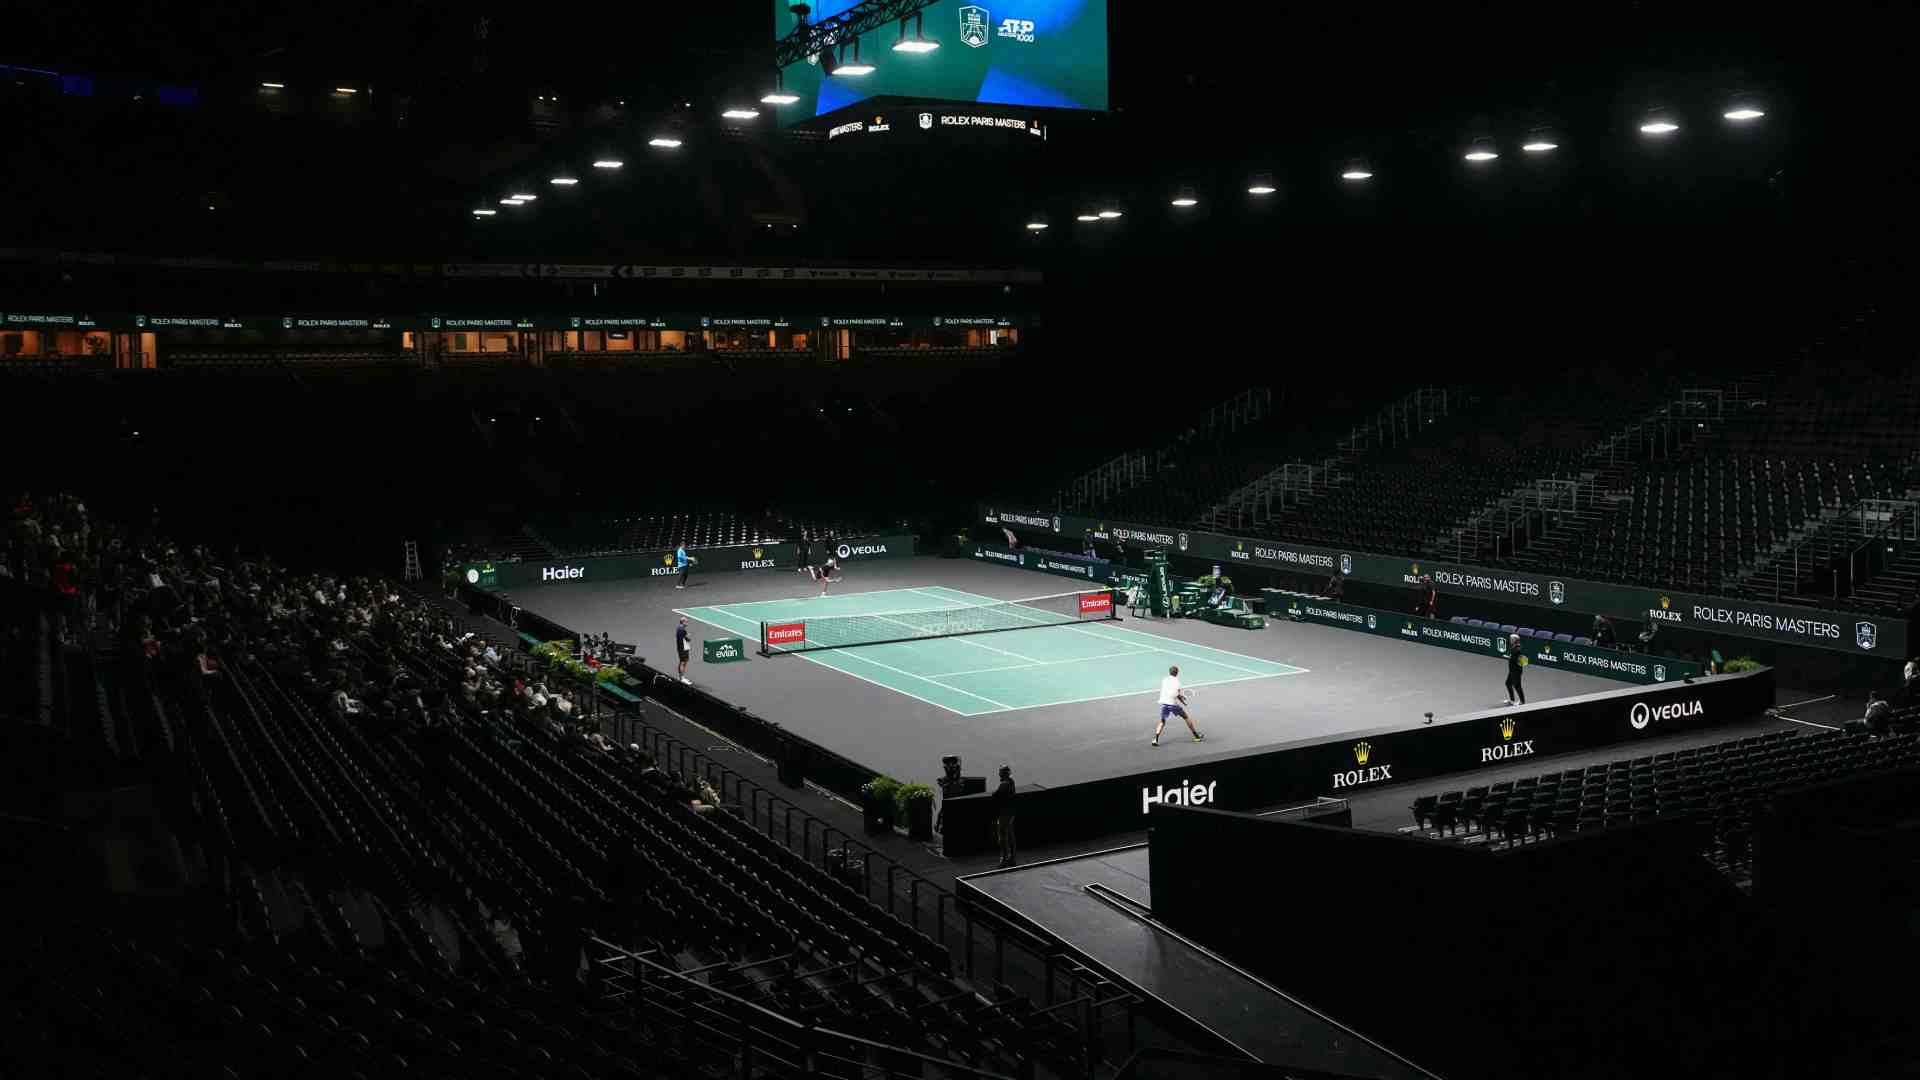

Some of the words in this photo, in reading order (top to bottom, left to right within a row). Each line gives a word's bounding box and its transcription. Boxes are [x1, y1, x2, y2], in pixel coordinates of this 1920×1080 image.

[999, 18, 1034, 32] ATP
[941, 115, 970, 125] ROLEX
[971, 117, 994, 126] PARIS
[995, 118, 1026, 129] MASTERS
[1113, 528, 1129, 538] ROLEX
[1130, 530, 1146, 541] PARIS
[1147, 533, 1174, 545] MASTERS
[852, 544, 886, 554] VEOLIA
[1255, 547, 1277, 559] ROLEX
[1278, 550, 1298, 562] PARIS
[1298, 552, 1333, 567] MASTERS
[651, 566, 679, 576] ROLE
[741, 559, 775, 568] ROLEX
[542, 565, 585, 581] Haier
[1404, 574, 1424, 584] ROL
[1435, 571, 1464, 585] ROLEX
[1466, 575, 1491, 589] PARIS
[1494, 579, 1539, 595] MASTERS
[1081, 598, 1110, 608] Emirates
[1304, 607, 1322, 616] ROLEX
[1322, 609, 1337, 619] PARIS
[1337, 611, 1363, 624] MASTERS
[1650, 609, 1682, 621] ROLEX
[1694, 606, 1733, 624] ROLEX
[1736, 611, 1773, 629] PARIS
[1776, 617, 1840, 638] MASTERS
[769, 628, 803, 639] Emirates
[1423, 627, 1442, 638] ROLEX
[1443, 630, 1460, 640] PARIS
[1461, 634, 1491, 647] MASTERS
[715, 649, 738, 659] evian
[1563, 652, 1587, 664] ROLEX
[1588, 657, 1609, 668] PARIS
[1610, 660, 1647, 674] MASTERS
[1652, 700, 1704, 720] VEOLIA
[1481, 740, 1535, 762] ROLEX
[1332, 764, 1392, 788] ROLEX
[1142, 779, 1217, 814] Haier
